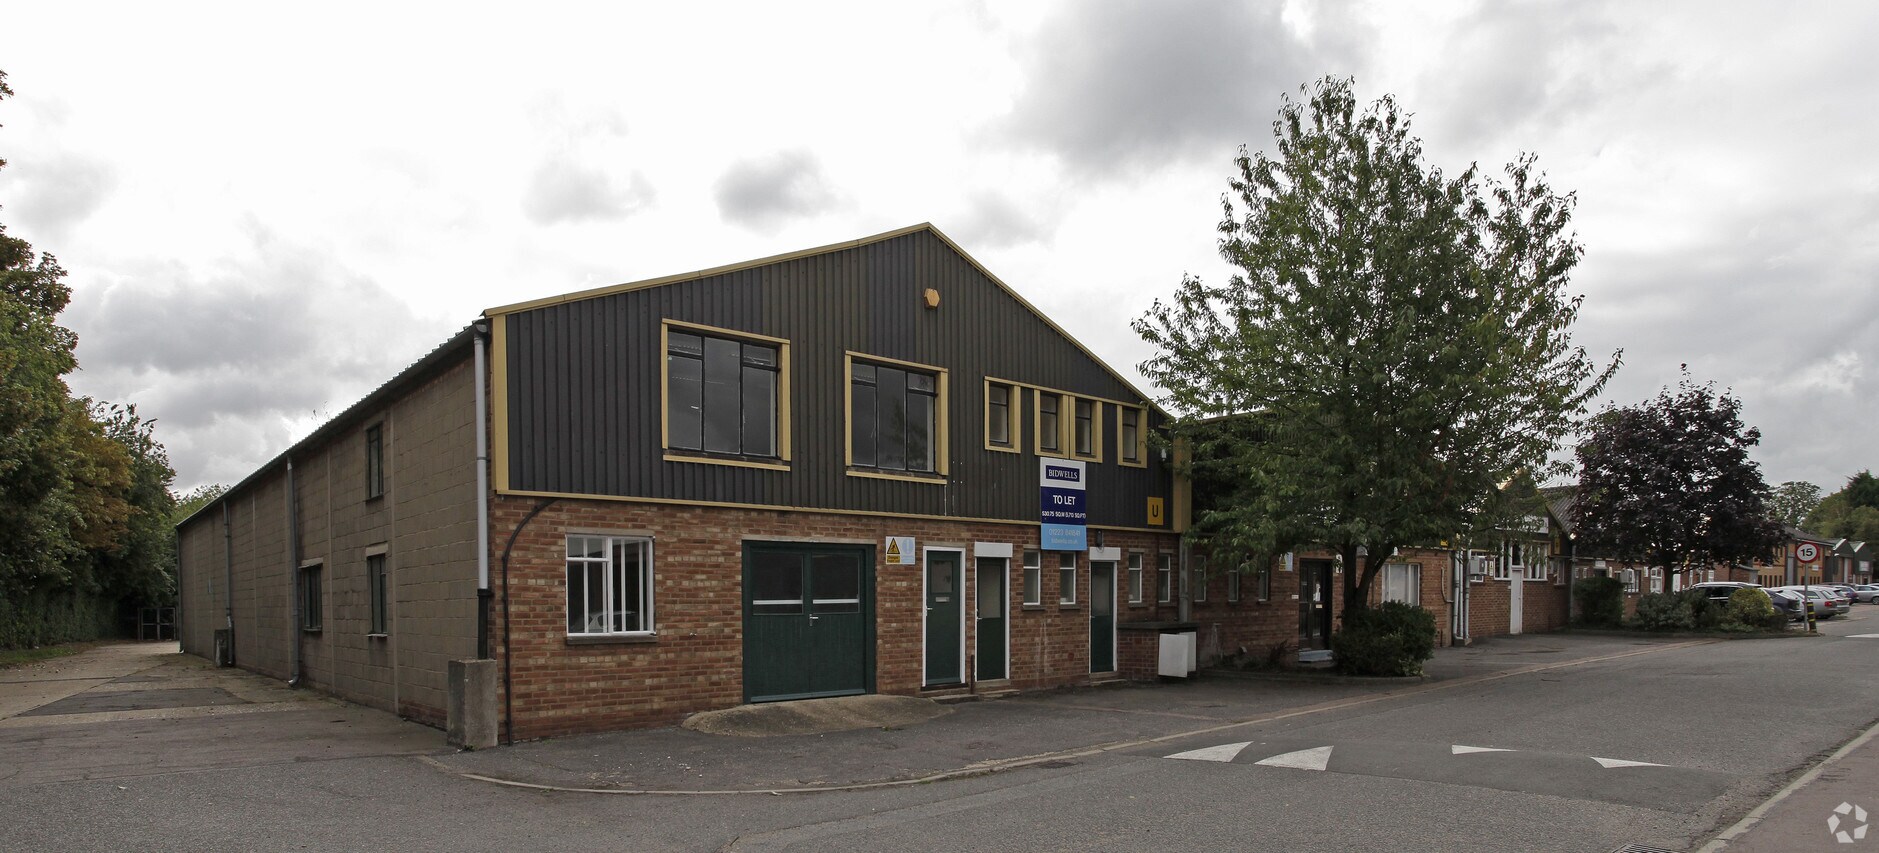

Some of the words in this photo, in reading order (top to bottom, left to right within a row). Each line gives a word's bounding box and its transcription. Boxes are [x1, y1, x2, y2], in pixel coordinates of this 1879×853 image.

[1048, 469, 1078, 480] BIDWELLS
[1052, 494, 1063, 505] TO
[1064, 495, 1076, 506] LET
[1152, 504, 1159, 517] U
[1800, 548, 1813, 557] 15
